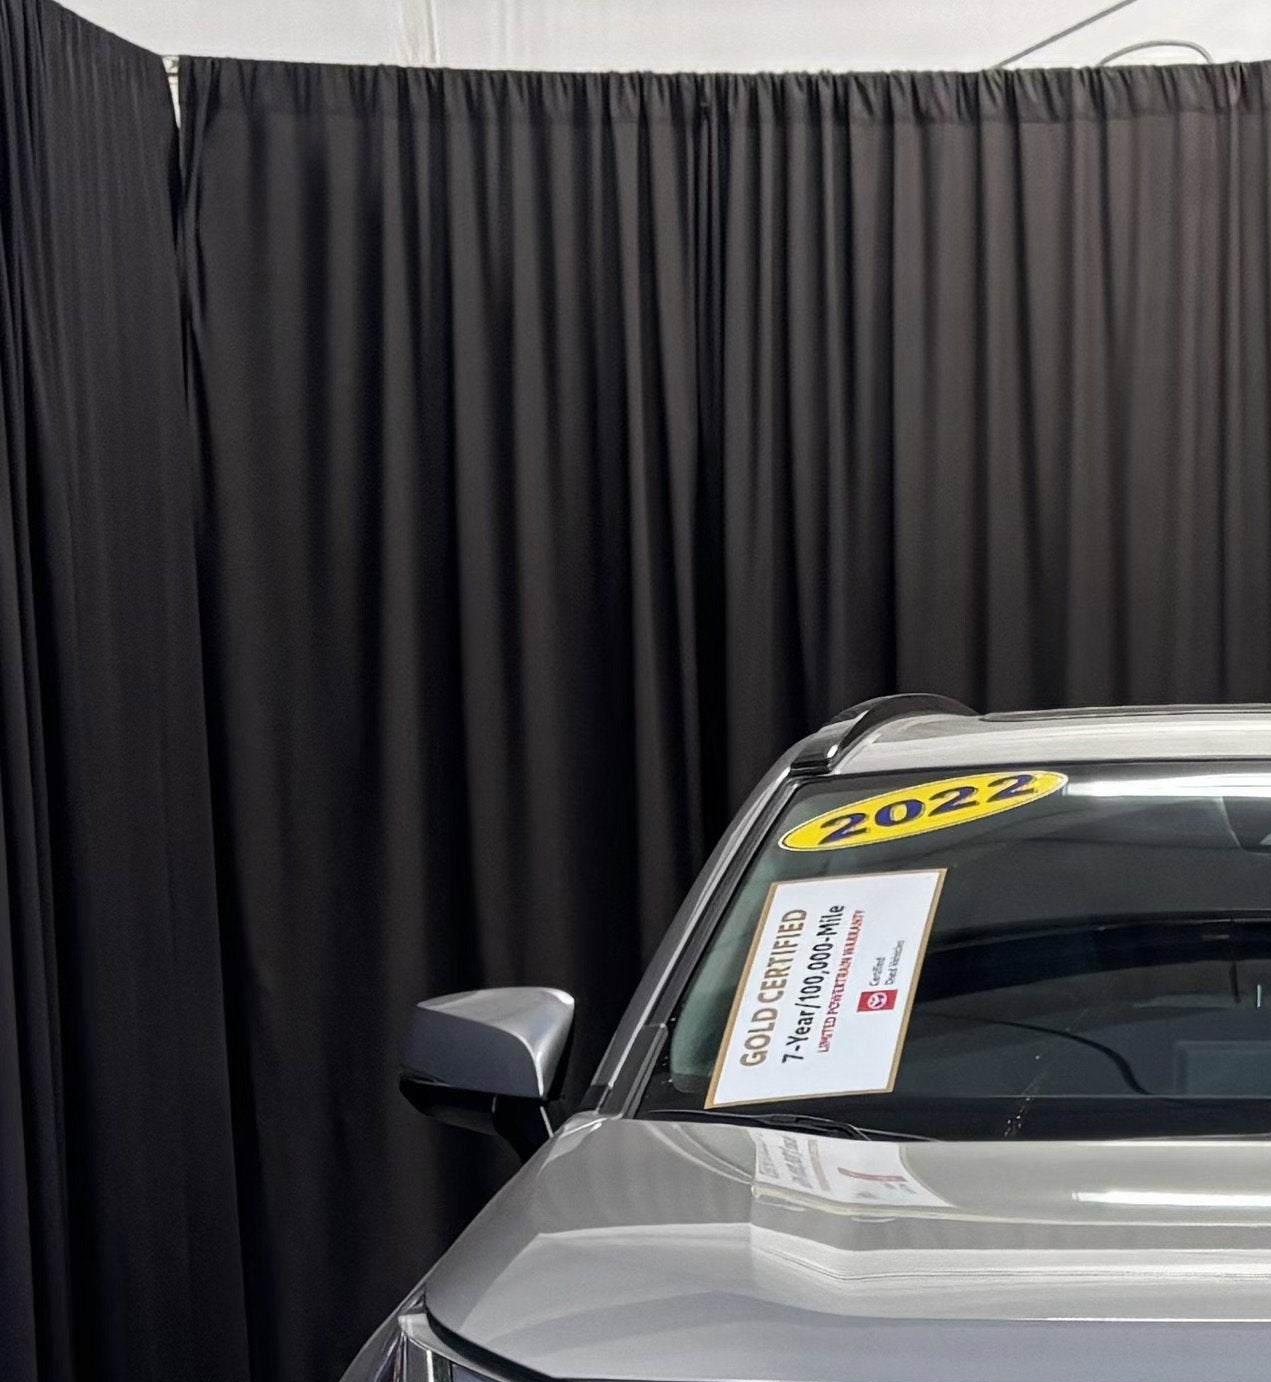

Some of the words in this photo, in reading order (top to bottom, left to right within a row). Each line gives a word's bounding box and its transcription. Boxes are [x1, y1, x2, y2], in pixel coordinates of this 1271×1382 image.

[818, 774, 1040, 846] 2022
[757, 908, 808, 1005] CERTIFIED
[782, 904, 845, 1064] 7-Year/100,000-Mile
[740, 1006, 779, 1068] GOLD
[818, 1016, 837, 1053] LIMITED
